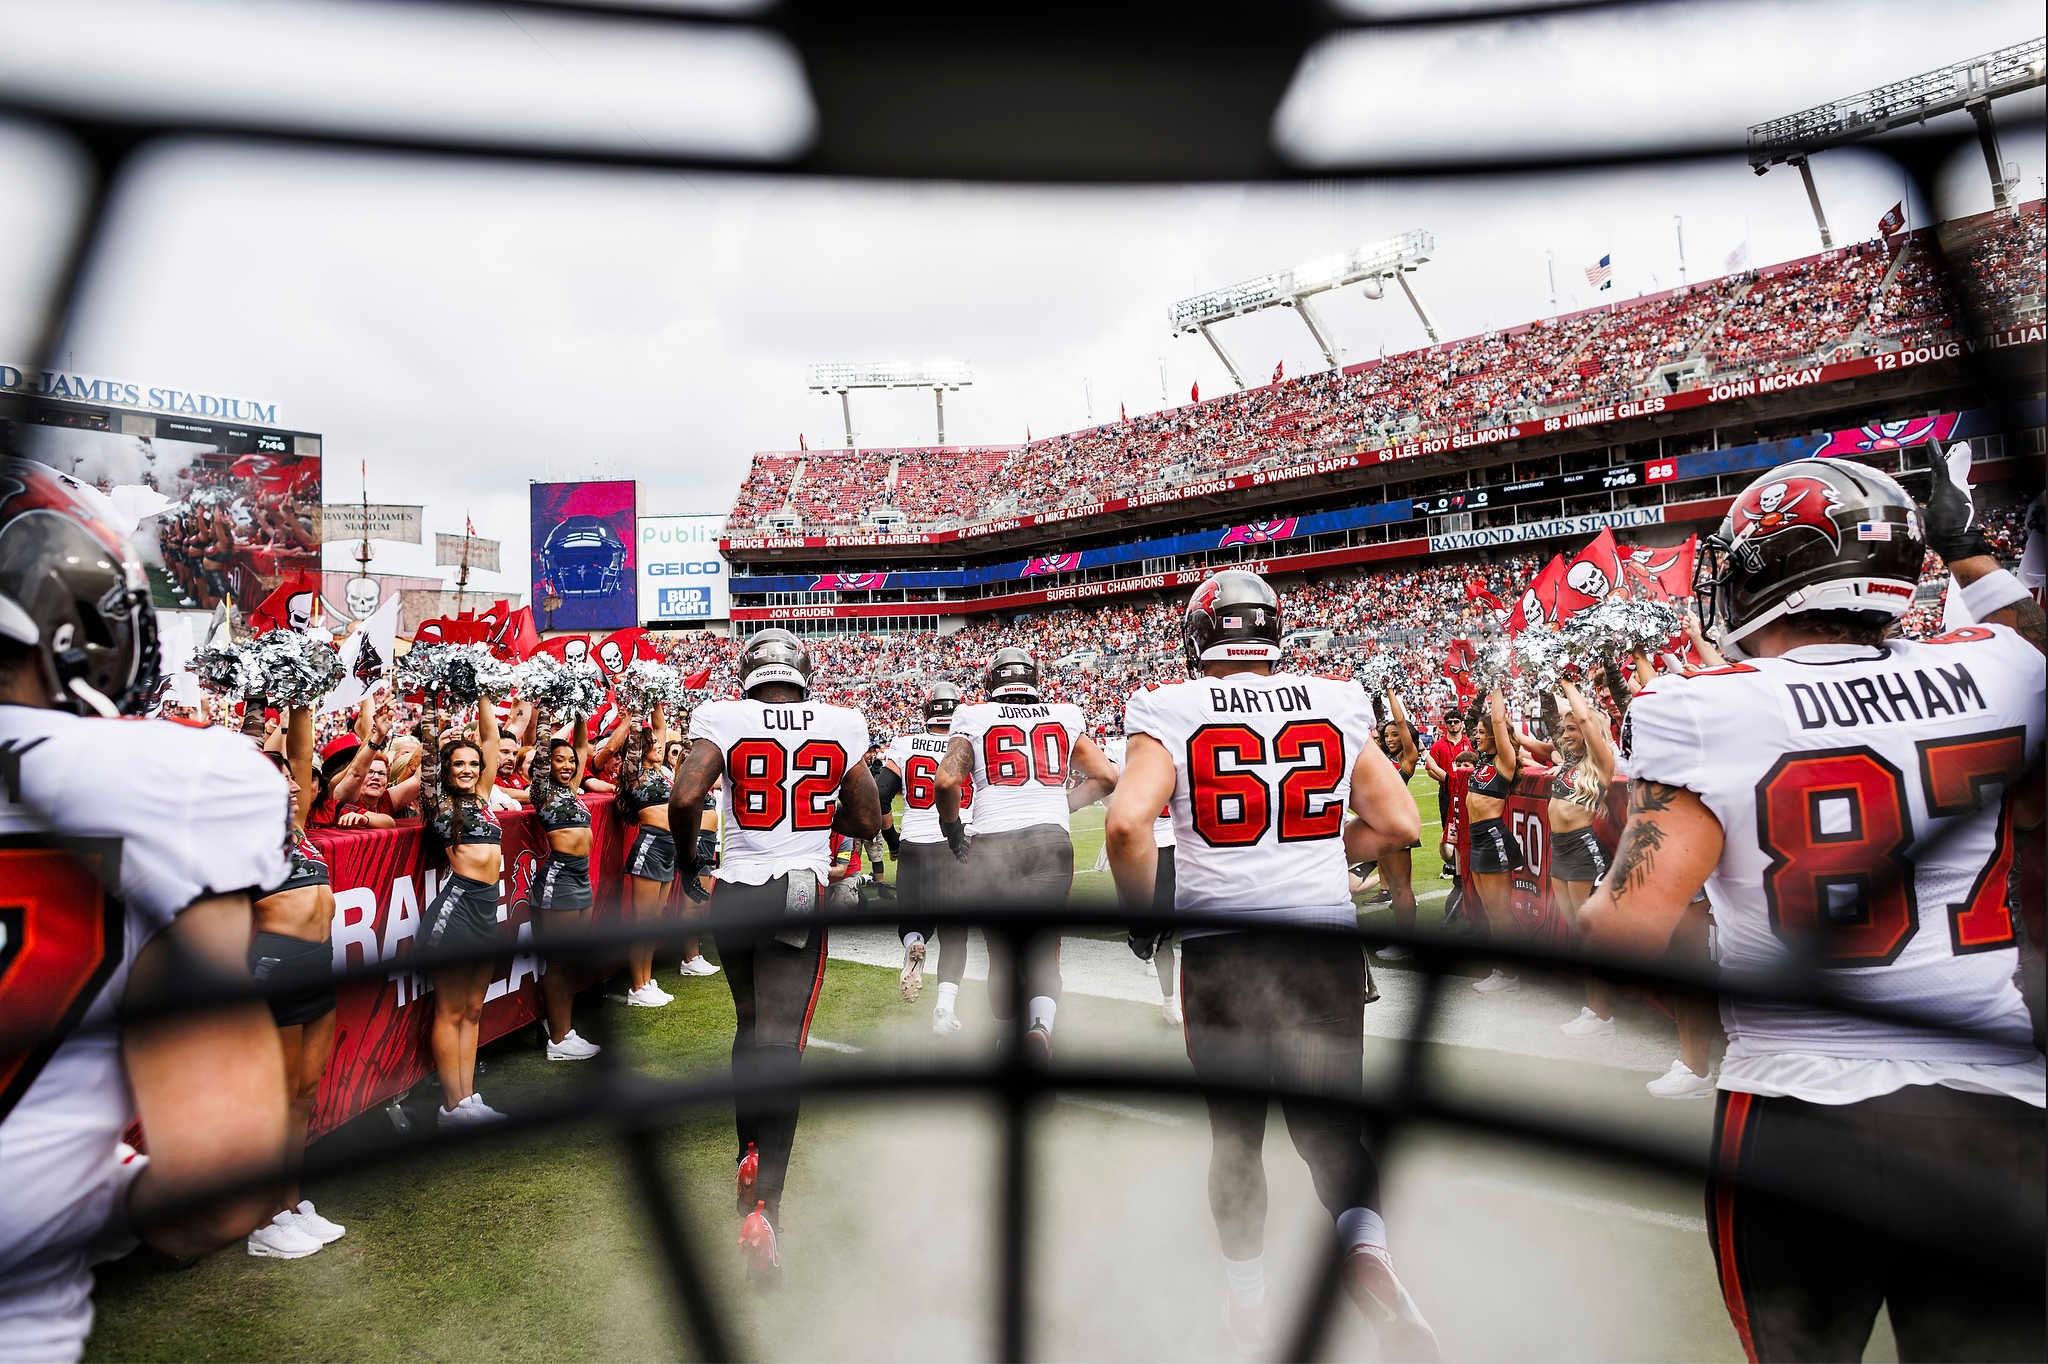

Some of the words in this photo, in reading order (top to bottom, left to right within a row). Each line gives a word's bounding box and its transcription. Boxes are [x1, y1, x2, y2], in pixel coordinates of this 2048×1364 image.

[1875, 353, 1897, 371] 12
[1901, 342, 1960, 366] DOUG
[1708, 382, 1754, 402] JOHN
[1759, 367, 1823, 393] MCKAY
[38, 371, 140, 406] JAMES
[148, 385, 279, 424] STADIUM
[1544, 417, 1561, 432] 88
[1563, 406, 1615, 428] JIMMIE
[1618, 397, 1666, 418] GILES
[1379, 448, 1393, 462] 63
[1396, 444, 1420, 459] LEE
[1422, 439, 1449, 454] ROY
[1452, 426, 1509, 449] SELMON
[1253, 472, 1265, 485] 99
[1267, 463, 1316, 482] WARREN
[1317, 457, 1349, 474] SAPP
[1602, 472, 1637, 487] 7:46
[1647, 464, 1673, 479] 25
[1128, 497, 1139, 508] 55
[1140, 489, 1181, 506] DERRICK
[1183, 481, 1226, 498] BROOKS
[1438, 498, 1449, 509] 0
[1477, 492, 1488, 503] 0
[324, 512, 377, 521] RAYMOND
[376, 513, 414, 521] JAMES
[1043, 510, 1065, 523] MIKE
[1067, 502, 1104, 519] ALSTOTT
[344, 523, 391, 531] STADIUM
[642, 525, 718, 544] Publix
[958, 529, 966, 539] 47
[967, 526, 989, 538] JOHN
[990, 522, 1014, 535] LYNCH
[1431, 527, 1515, 552] RAYMOND
[1516, 520, 1576, 541] JAMES
[1579, 506, 1662, 532] STADIUM
[730, 539, 766, 550] BRUCE
[767, 537, 805, 549] ARIANS
[826, 536, 838, 547] 20
[878, 534, 921, 545] BARBER
[648, 561, 721, 576] GEICO
[1176, 571, 1200, 584] 2002
[666, 588, 702, 602] BUD
[1047, 587, 1077, 601] SUPER
[1079, 584, 1106, 598] BOWL
[1107, 576, 1165, 594] CHAMPIONS
[770, 608, 791, 619] JON
[792, 607, 834, 619] GRUDEN
[755, 669, 777, 678] CHOOSE
[778, 669, 793, 677] LOVE
[1209, 684, 1312, 714] BARTON
[1784, 662, 1987, 731] DURHAM
[763, 708, 814, 732] CULP
[997, 705, 1051, 720] JORDAN
[911, 738, 949, 753] BREDE
[982, 721, 1070, 787] 60
[725, 737, 848, 832] 82
[1186, 718, 1346, 848] 62
[1754, 724, 2028, 970] 87
